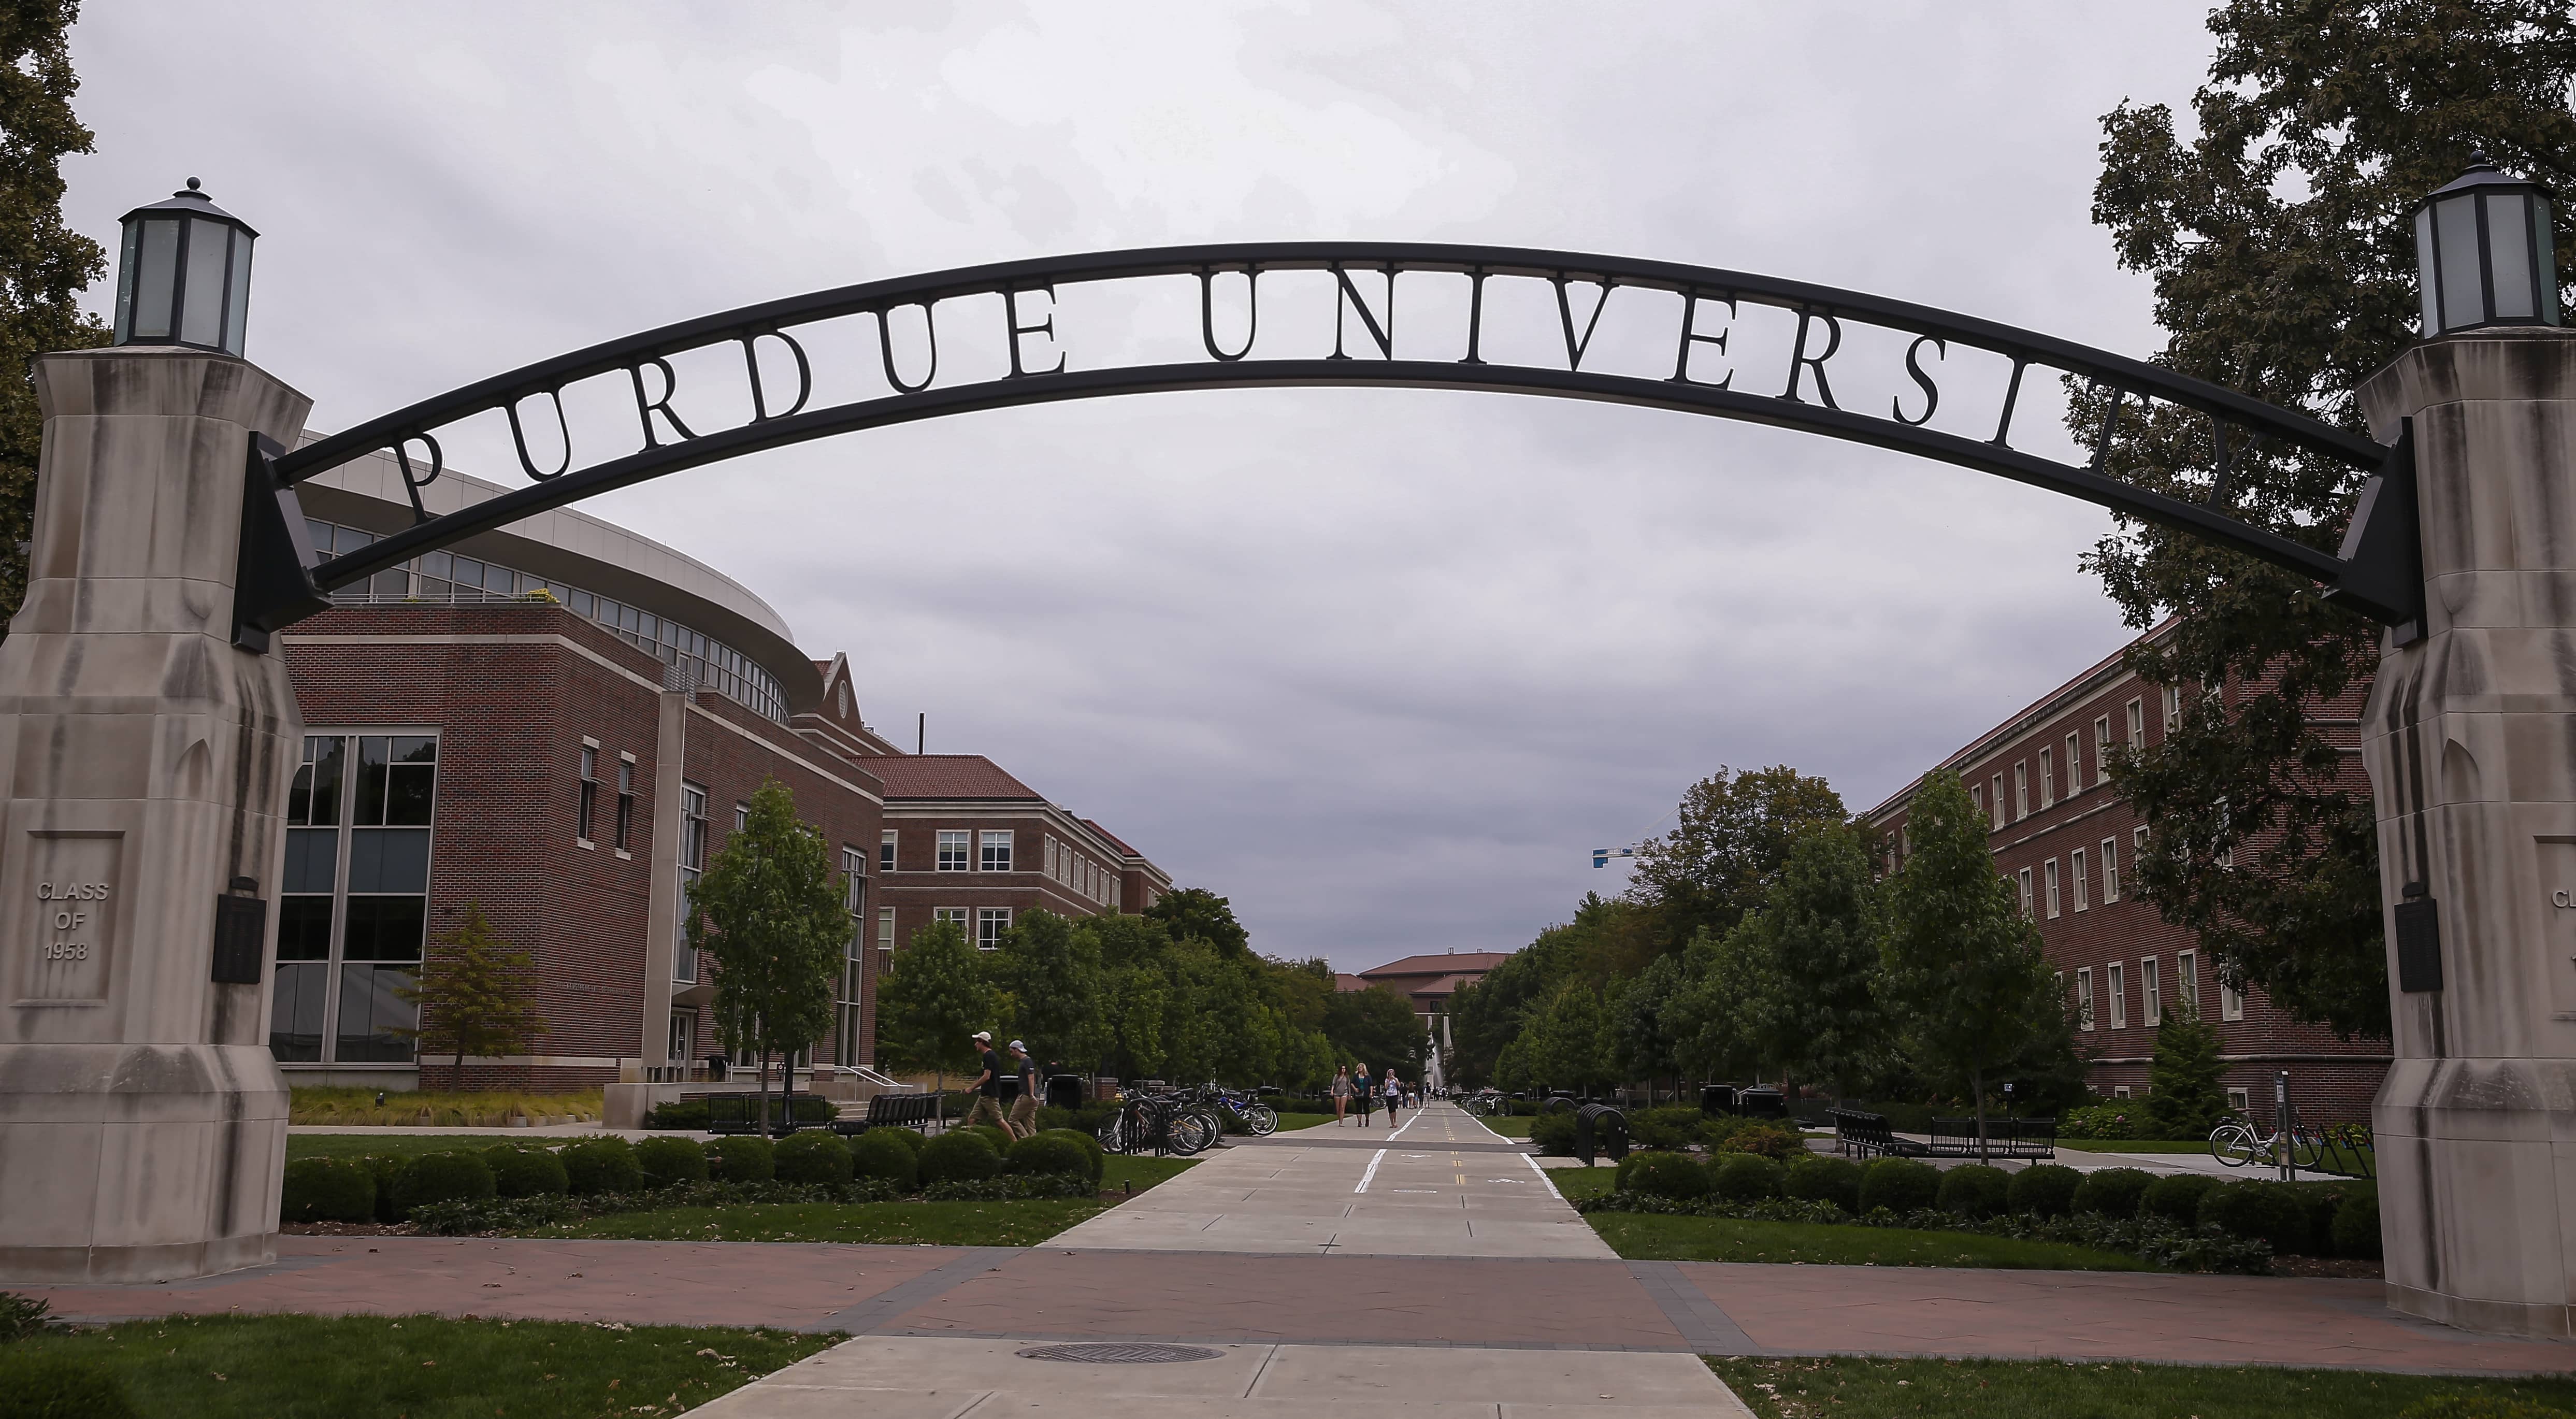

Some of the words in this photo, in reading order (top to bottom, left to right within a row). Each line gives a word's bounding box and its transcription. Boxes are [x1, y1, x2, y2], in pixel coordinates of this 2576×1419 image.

[383, 282, 1067, 523] PURDUE
[1190, 267, 2263, 504] UNIVERSITY
[36, 881, 110, 900] CLASS
[54, 911, 86, 930] OF
[45, 941, 89, 961] 1958
